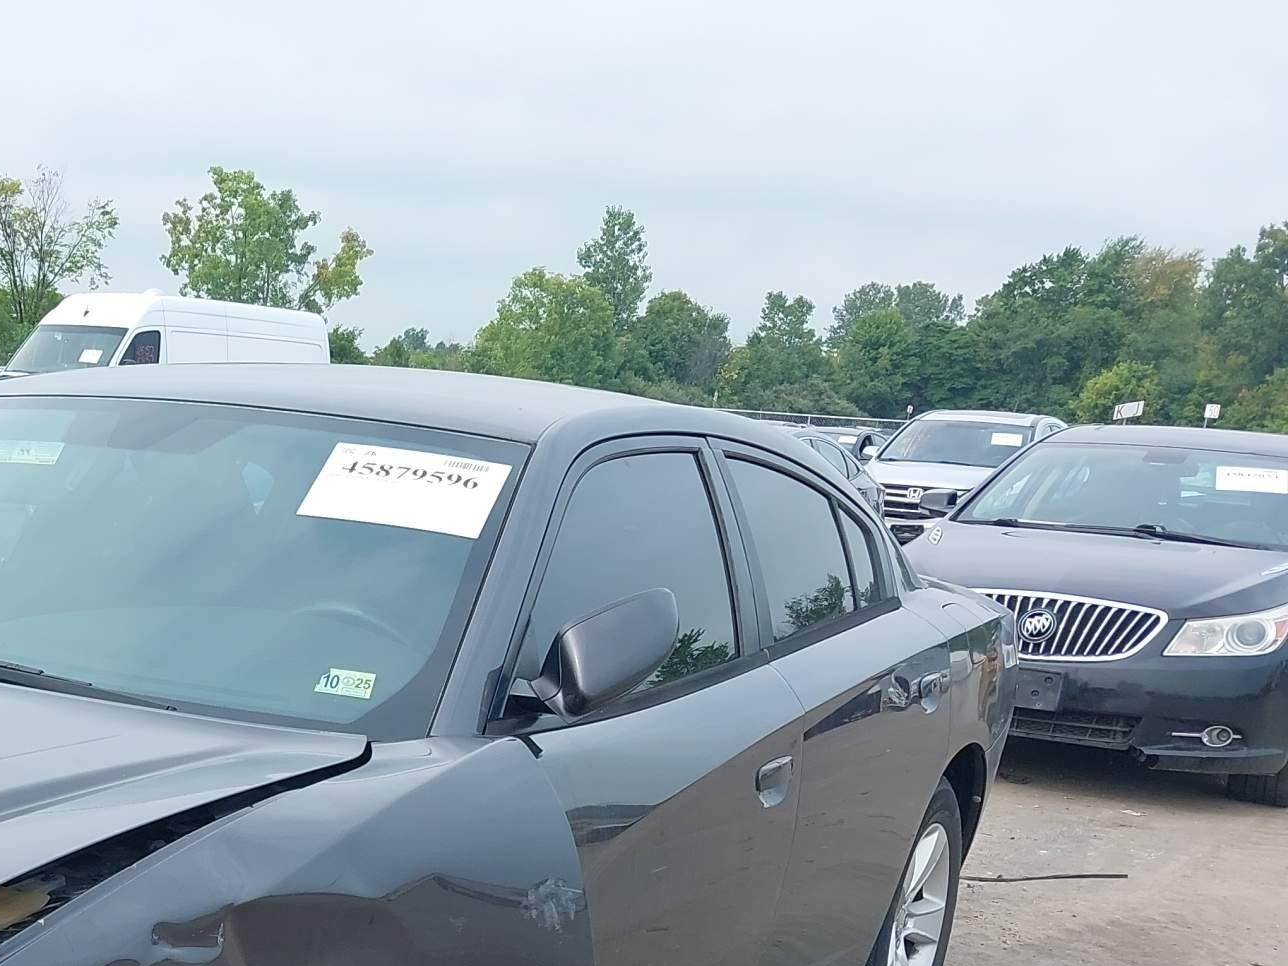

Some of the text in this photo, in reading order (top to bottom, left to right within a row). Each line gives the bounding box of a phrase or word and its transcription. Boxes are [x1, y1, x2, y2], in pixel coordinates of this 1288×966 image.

[341, 460, 479, 490] 45879596
[323, 673, 372, 690] 10 25
